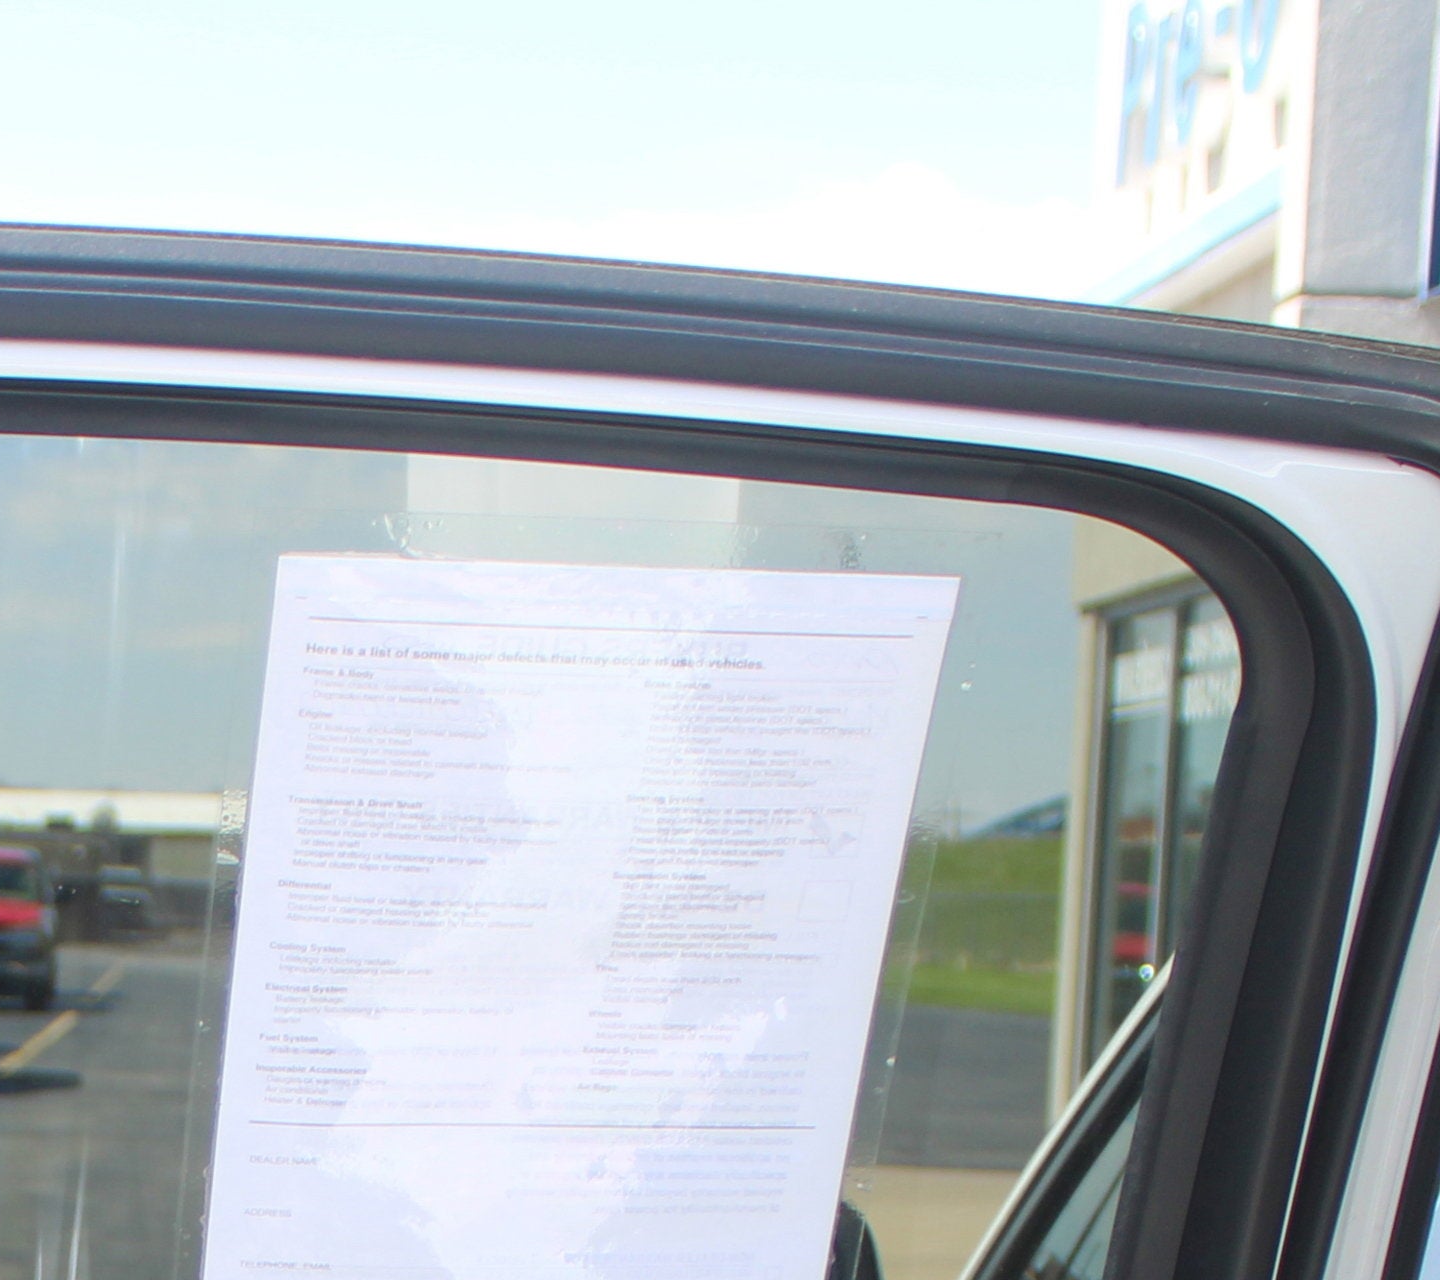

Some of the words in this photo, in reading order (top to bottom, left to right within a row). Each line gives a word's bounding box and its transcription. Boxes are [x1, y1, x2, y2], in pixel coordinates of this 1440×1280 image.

[305, 644, 339, 657] Here
[342, 645, 354, 657] is
[358, 648, 366, 657] a
[370, 646, 391, 658] list
[395, 647, 409, 659] of
[412, 650, 450, 660] some
[453, 651, 493, 664] major
[497, 650, 546, 663] defects
[550, 652, 578, 664] that
[580, 655, 607, 668] may
[612, 656, 650, 667] occur
[708, 657, 766, 670] vehicles.
[277, 878, 332, 890] Differential
[268, 940, 308, 954] Cooling
[309, 942, 347, 955] System
[258, 1031, 281, 1042] Fuel
[282, 1032, 319, 1045] System
[255, 1062, 307, 1076] Inoperable
[308, 1063, 368, 1075] Accessories
[248, 1154, 288, 1165] DEALER
[289, 1156, 318, 1166] NAME
[243, 1207, 293, 1218] ADDRESS
